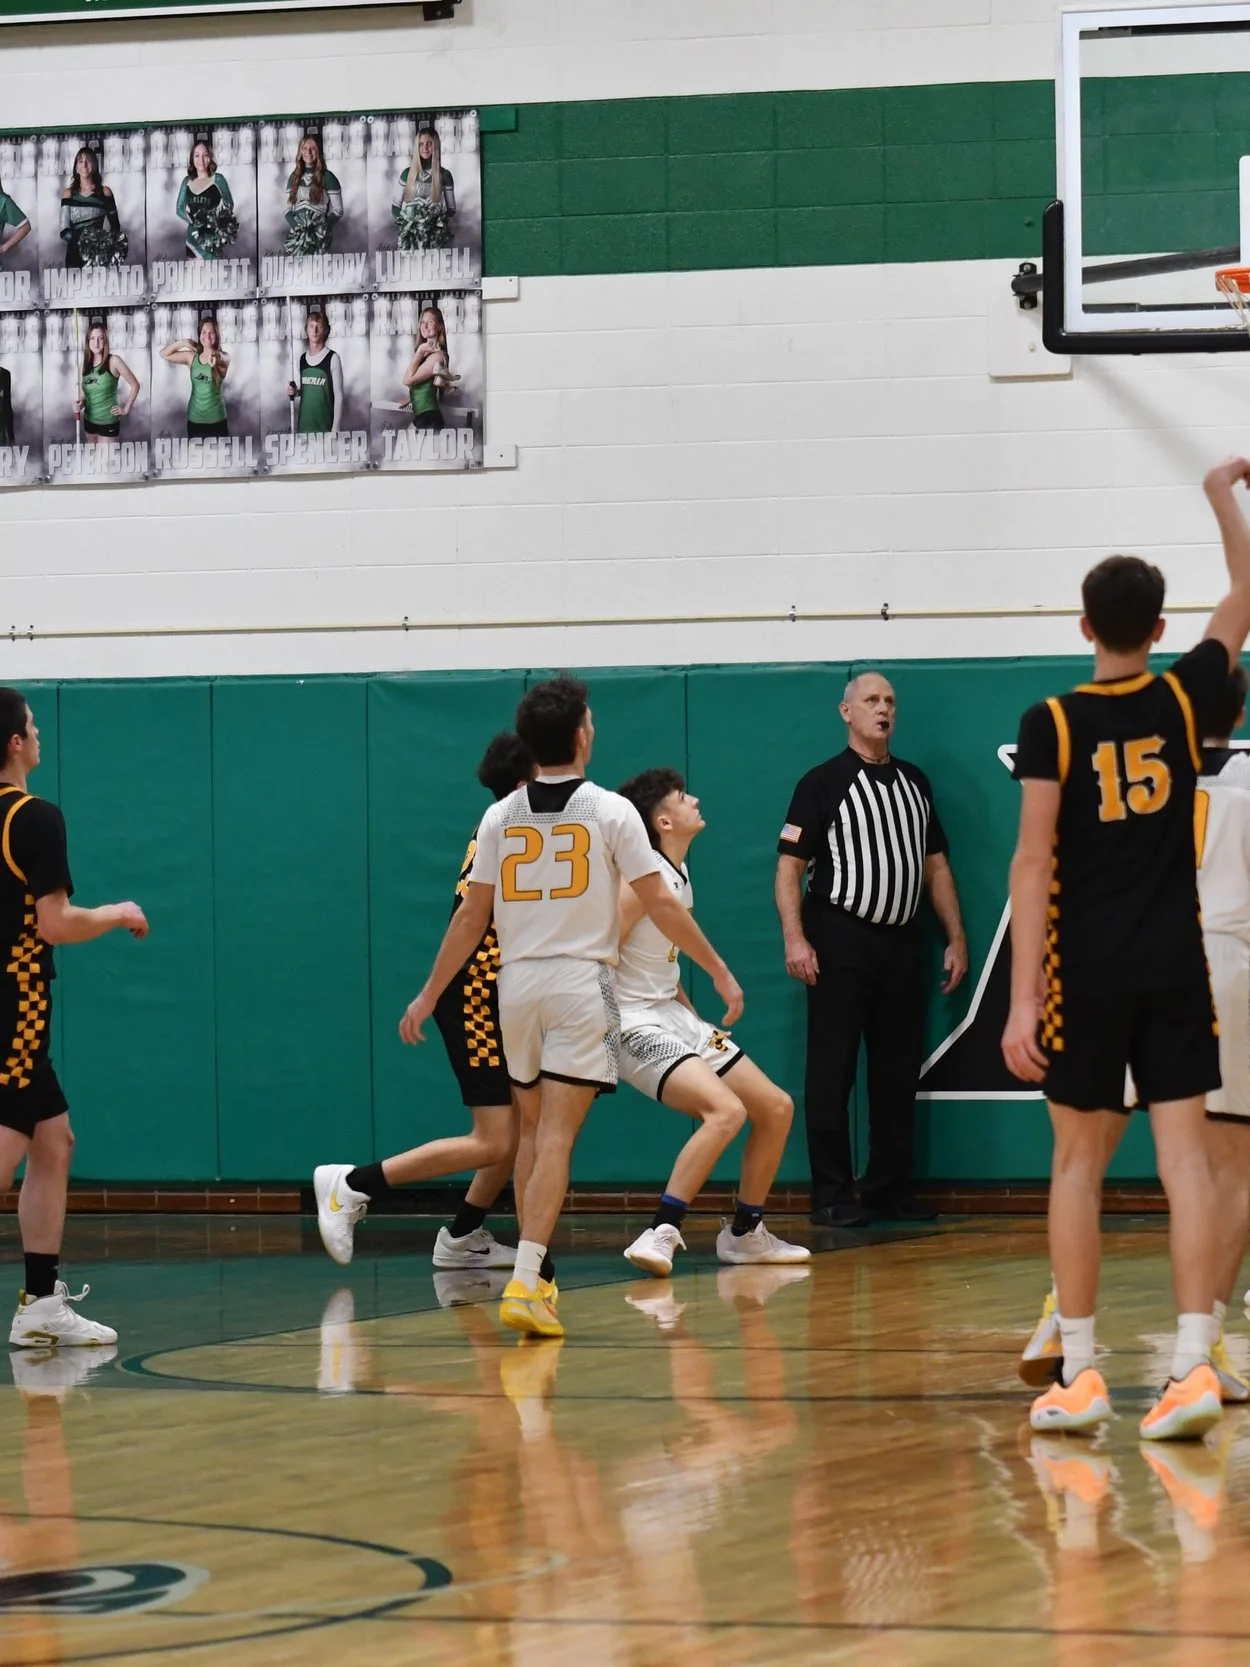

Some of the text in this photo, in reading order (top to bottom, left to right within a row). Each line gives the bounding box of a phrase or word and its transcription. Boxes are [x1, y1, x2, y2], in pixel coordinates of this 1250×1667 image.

[152, 258, 251, 292] PRITCHETT
[261, 252, 367, 288] DUSENBERRY
[375, 247, 475, 282] LUTTRELL
[44, 265, 145, 300] IMPERATO
[49, 441, 148, 476] PETERSON
[154, 436, 259, 471] RUSSELL
[264, 430, 368, 466] SPENCER
[381, 428, 475, 462] TAYLOR
[1091, 735, 1173, 822] 15
[501, 823, 591, 902] 23
